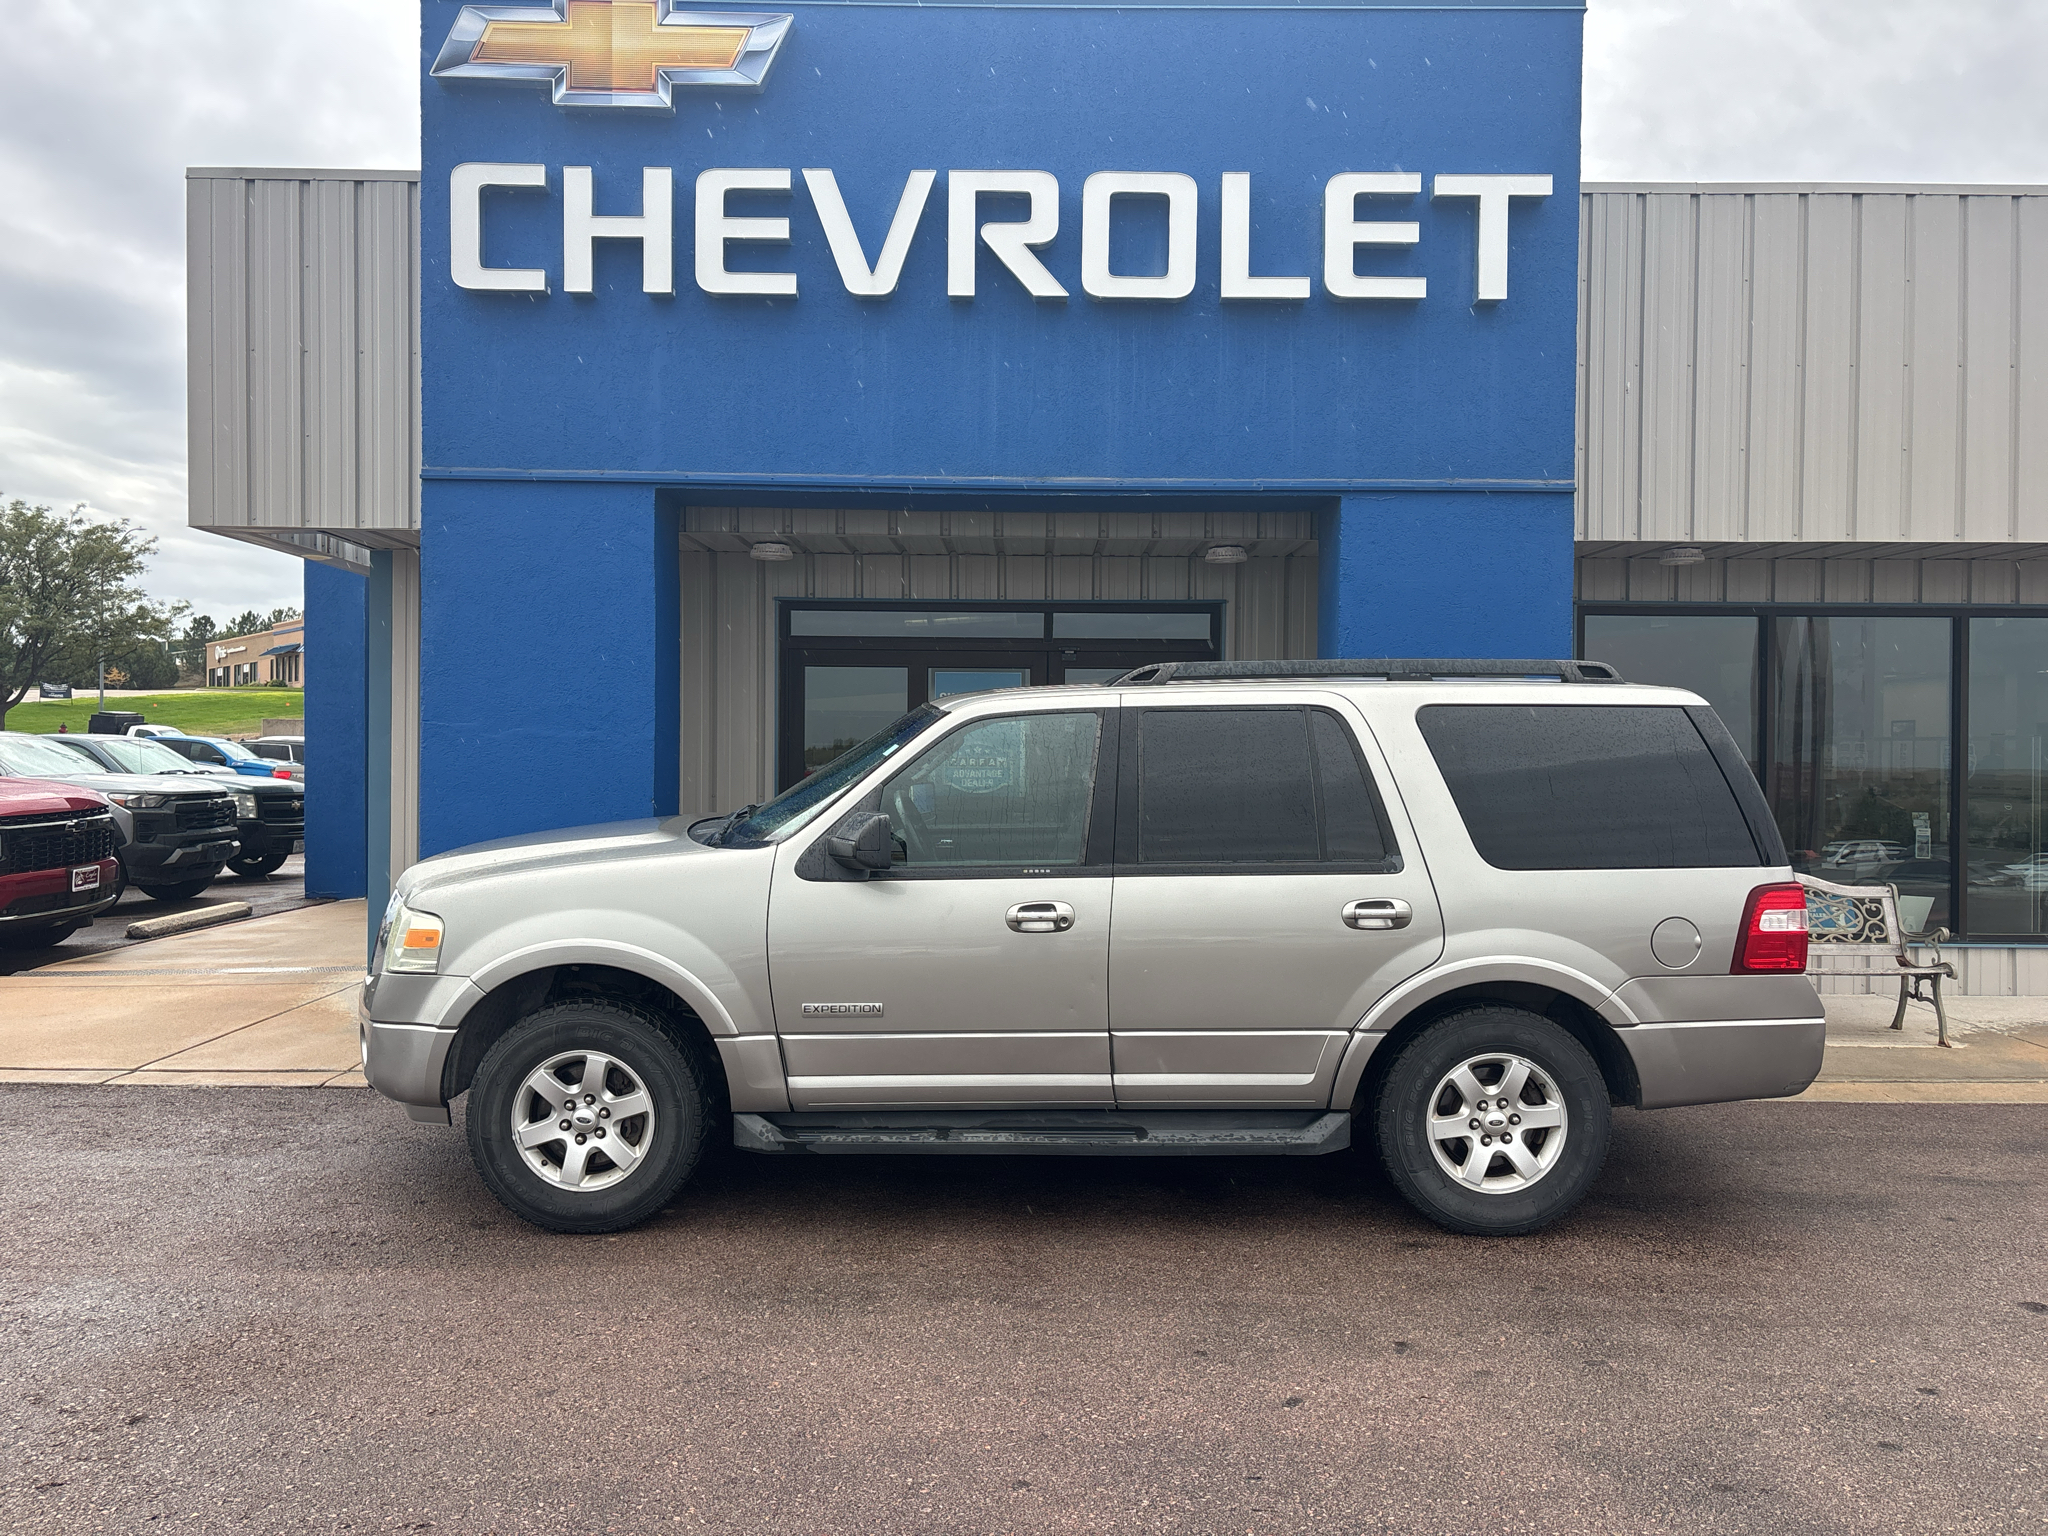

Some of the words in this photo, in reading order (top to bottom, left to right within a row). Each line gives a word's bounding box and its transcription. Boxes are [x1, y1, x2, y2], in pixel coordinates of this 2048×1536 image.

[450, 162, 1554, 302] CHEVROLET
[953, 769, 1003, 778] ADVANTAGE
[803, 1005, 882, 1013] EXPEDITION
[576, 1026, 615, 1042] BIG
[1408, 1053, 1442, 1104] FOOT
[1403, 1109, 1416, 1147] BIG
